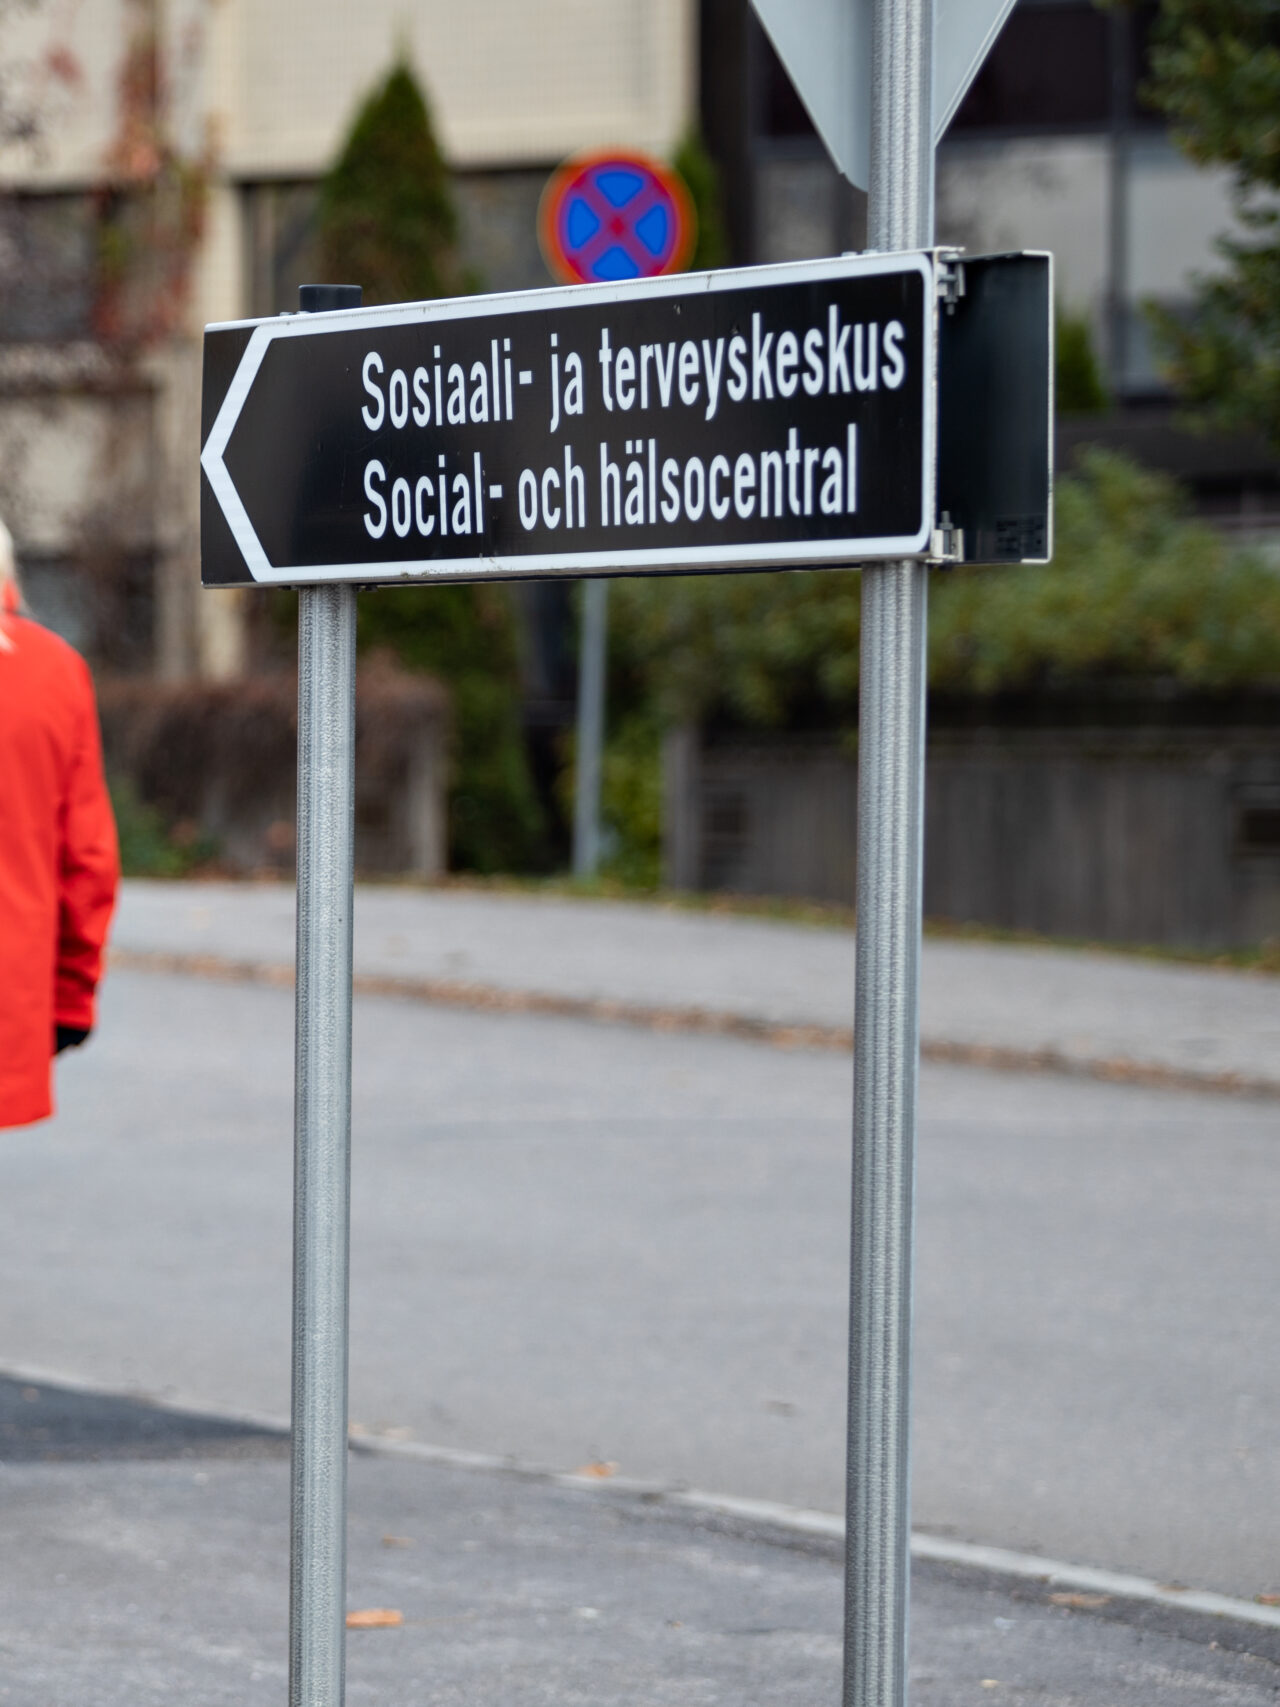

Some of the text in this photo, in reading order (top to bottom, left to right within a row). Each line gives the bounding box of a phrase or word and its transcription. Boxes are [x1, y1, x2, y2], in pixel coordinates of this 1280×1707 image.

[361, 304, 905, 433] Sosiaali- ja terveyskeskus
[363, 423, 857, 539] Social- och hälsocentral
